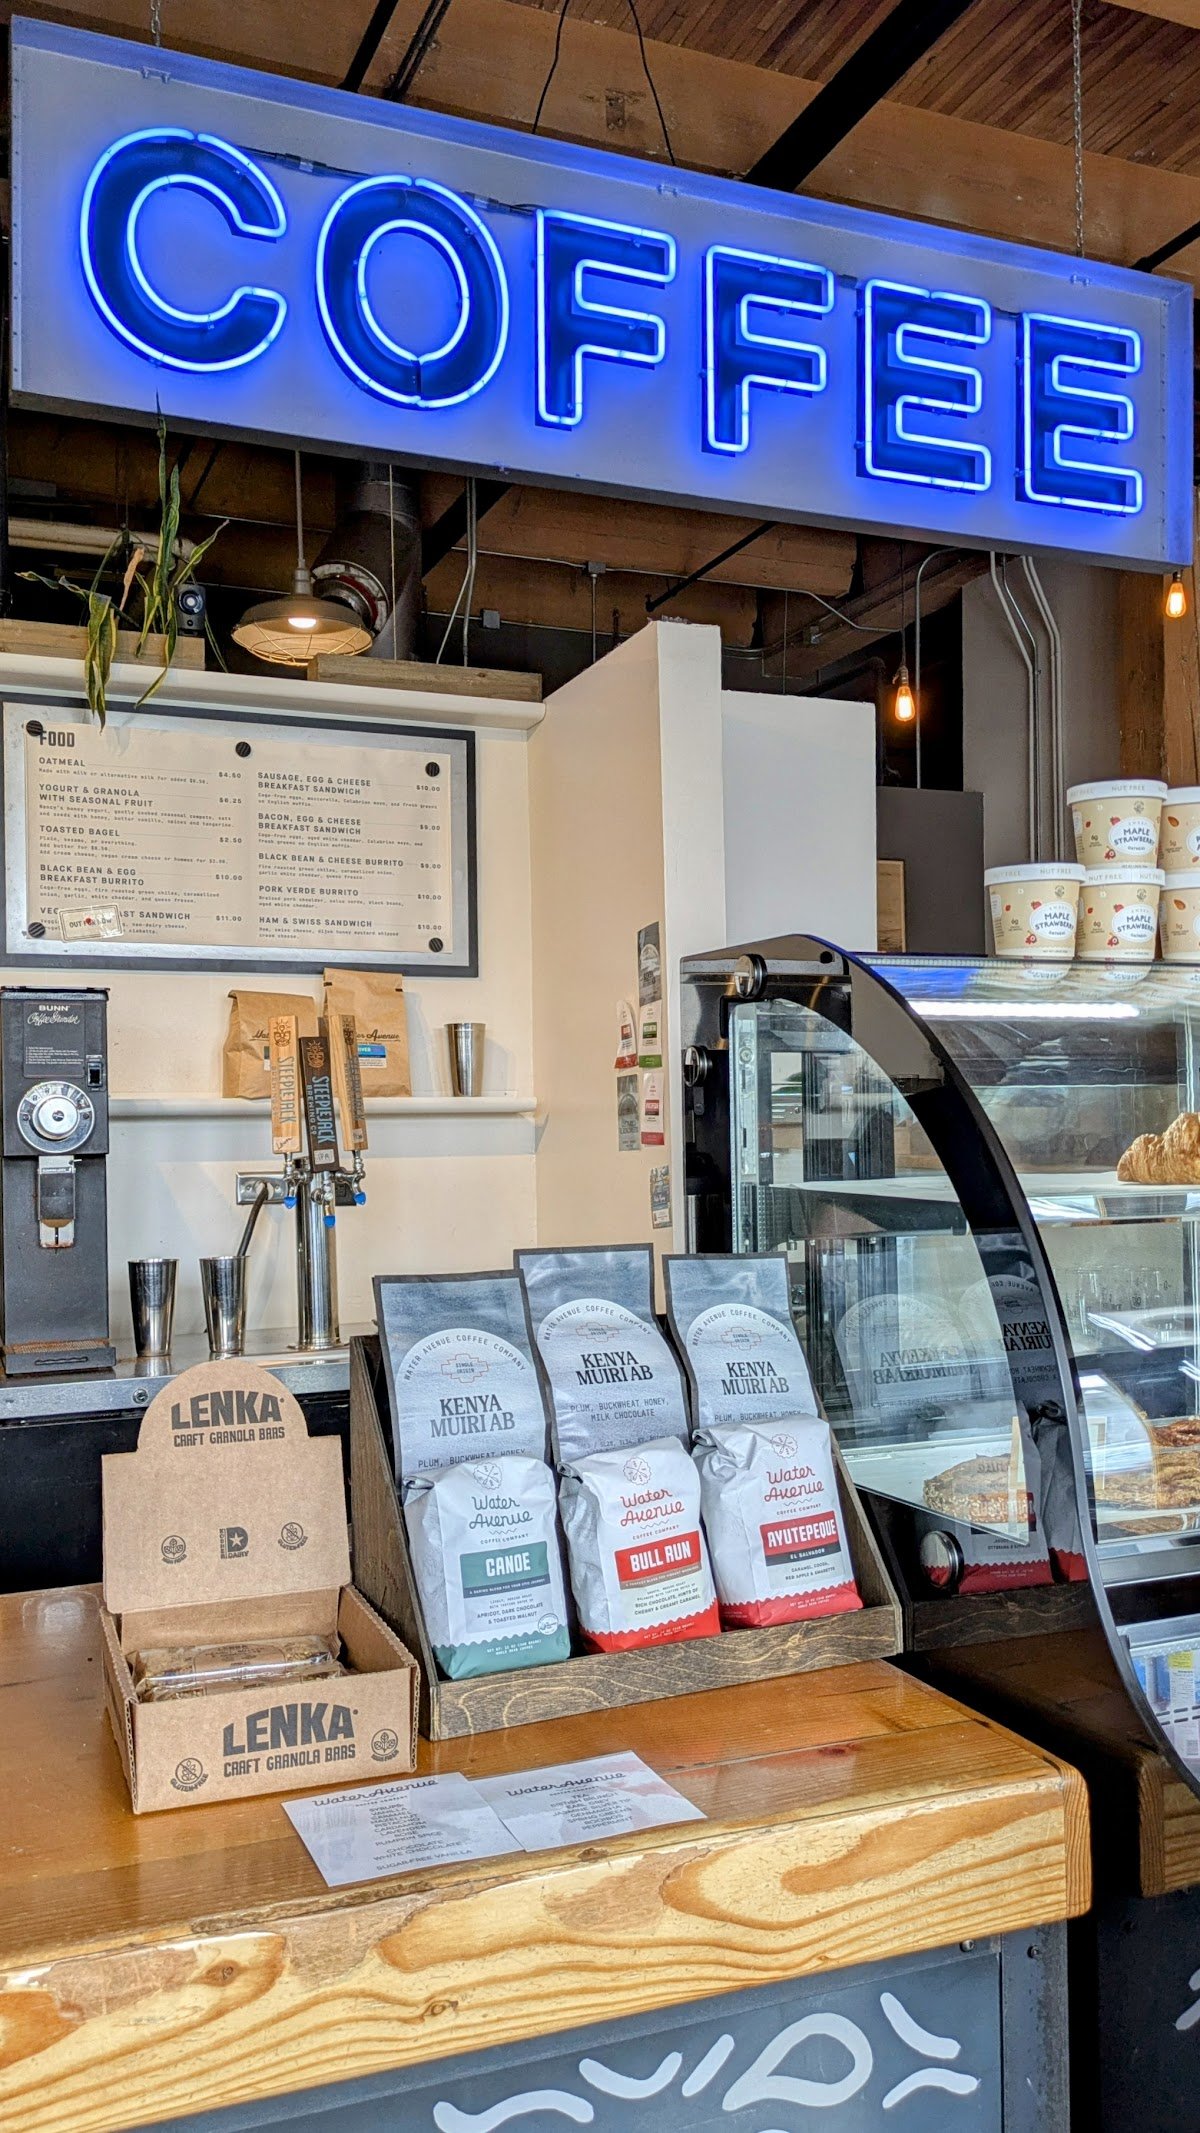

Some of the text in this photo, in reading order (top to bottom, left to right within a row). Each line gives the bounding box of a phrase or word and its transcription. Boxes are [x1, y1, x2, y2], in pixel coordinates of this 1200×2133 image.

[79, 126, 1144, 515] COFFEE
[40, 730, 75, 747] FOOD
[39, 757, 85, 767] OATMEAL
[258, 772, 302, 783] SAUSAGE,
[307, 776, 324, 784] EGG
[337, 778, 371, 787] CHEESE
[39, 784, 79, 793] YOGURT
[94, 787, 139, 797] GRANOLA
[258, 782, 360, 795] BREAKFAST SANDWICH
[40, 794, 153, 807] WITH SEASONAL FRUIT
[258, 813, 293, 822] BACON,
[297, 815, 314, 823] EGG
[327, 817, 361, 826] CHEESE
[40, 825, 85, 835] TOASTED
[89, 828, 120, 837] BAGEL
[259, 822, 361, 835] BREAKFAST SANDWICH
[1123, 827, 1150, 836] MAPLE
[259, 853, 287, 861] BLACK
[291, 855, 315, 863] BEAN
[328, 857, 362, 865] CHEESE
[366, 858, 404, 867] BURRITO
[40, 864, 72, 873] BLACK
[77, 866, 102, 874] BEAN
[117, 868, 136, 876] EGG
[40, 874, 144, 886] BREAKFAST BURRITO
[259, 885, 283, 893] PORK
[287, 887, 316, 895] VERDE
[320, 888, 358, 896] BURRITO
[139, 911, 190, 920] SANDWICH
[292, 918, 321, 926] SWISS
[325, 919, 372, 928] SANDWICH
[1044, 912, 1070, 921] MAPLE
[1126, 915, 1151, 924] MAPLE
[366, 1029, 400, 1042] Avenue
[277, 1055, 297, 1124] STEEPLEJACK
[306, 1085, 316, 1123] BREWING
[312, 1075, 336, 1144] STEEPLEJACK
[556, 1306, 581, 1321] AVENUE
[586, 1305, 614, 1316] COFFEE
[620, 1314, 651, 1335] COMPANY
[703, 1310, 726, 1326] AVENUE
[730, 1310, 757, 1320] COFFEE
[761, 1318, 791, 1342] COMPANY
[404, 1335, 526, 1380] WATER AVENUE COFFEE COMPANY
[581, 1351, 639, 1368] KENYA
[576, 1365, 653, 1385] MUIRI AB
[726, 1361, 777, 1377] KENYA
[721, 1377, 789, 1395] MUIRI AB
[171, 1390, 283, 1430] LENKA
[440, 1394, 502, 1416] KENYA
[570, 1398, 669, 1412] PLUM, BUCKWHEAT HONEY,
[591, 1409, 655, 1421] MILK CHOCOLATE
[740, 1412, 777, 1420] BUCKWHEAT
[430, 1412, 515, 1438] MUIRI AB
[174, 1427, 285, 1447] CRAFT GRANOLA BARS
[418, 1452, 495, 1468] PLUM, BUCKWHEAT
[766, 1466, 815, 1484] Water
[620, 1489, 672, 1508] Water
[764, 1481, 824, 1502] Avenue
[472, 1496, 520, 1511] Water
[799, 1503, 821, 1512] COMPANY
[469, 1511, 533, 1529] Avenue
[621, 1501, 685, 1527] Avenue
[503, 1533, 529, 1542] COMPANY
[633, 1525, 679, 1540] COFFEE COMPANY
[767, 1519, 836, 1547] AYUTEPEQUE
[630, 1541, 691, 1573] BULL RUN
[799, 1548, 825, 1558] SALVADOR
[486, 1552, 531, 1577] CANOE
[649, 1595, 676, 1605] CHOCOLATE,
[680, 1595, 701, 1607] CARAMEL
[477, 1610, 501, 1619] APRICOT,
[516, 1602, 544, 1612] CHOCOLATE
[494, 1615, 516, 1624] TOASTED
[517, 1611, 537, 1620] WALNUT
[223, 1702, 355, 1757] LENKA
[224, 1758, 260, 1777] CRAFT
[267, 1750, 320, 1771] GRANOLA
[325, 1744, 356, 1762] BARS
[170, 1773, 209, 1792] GLUTEN-FREE
[506, 1784, 558, 1797] Water
[558, 1773, 626, 1789] Avenue
[312, 1793, 368, 1807] Water
[367, 1780, 438, 1797] Avenue
